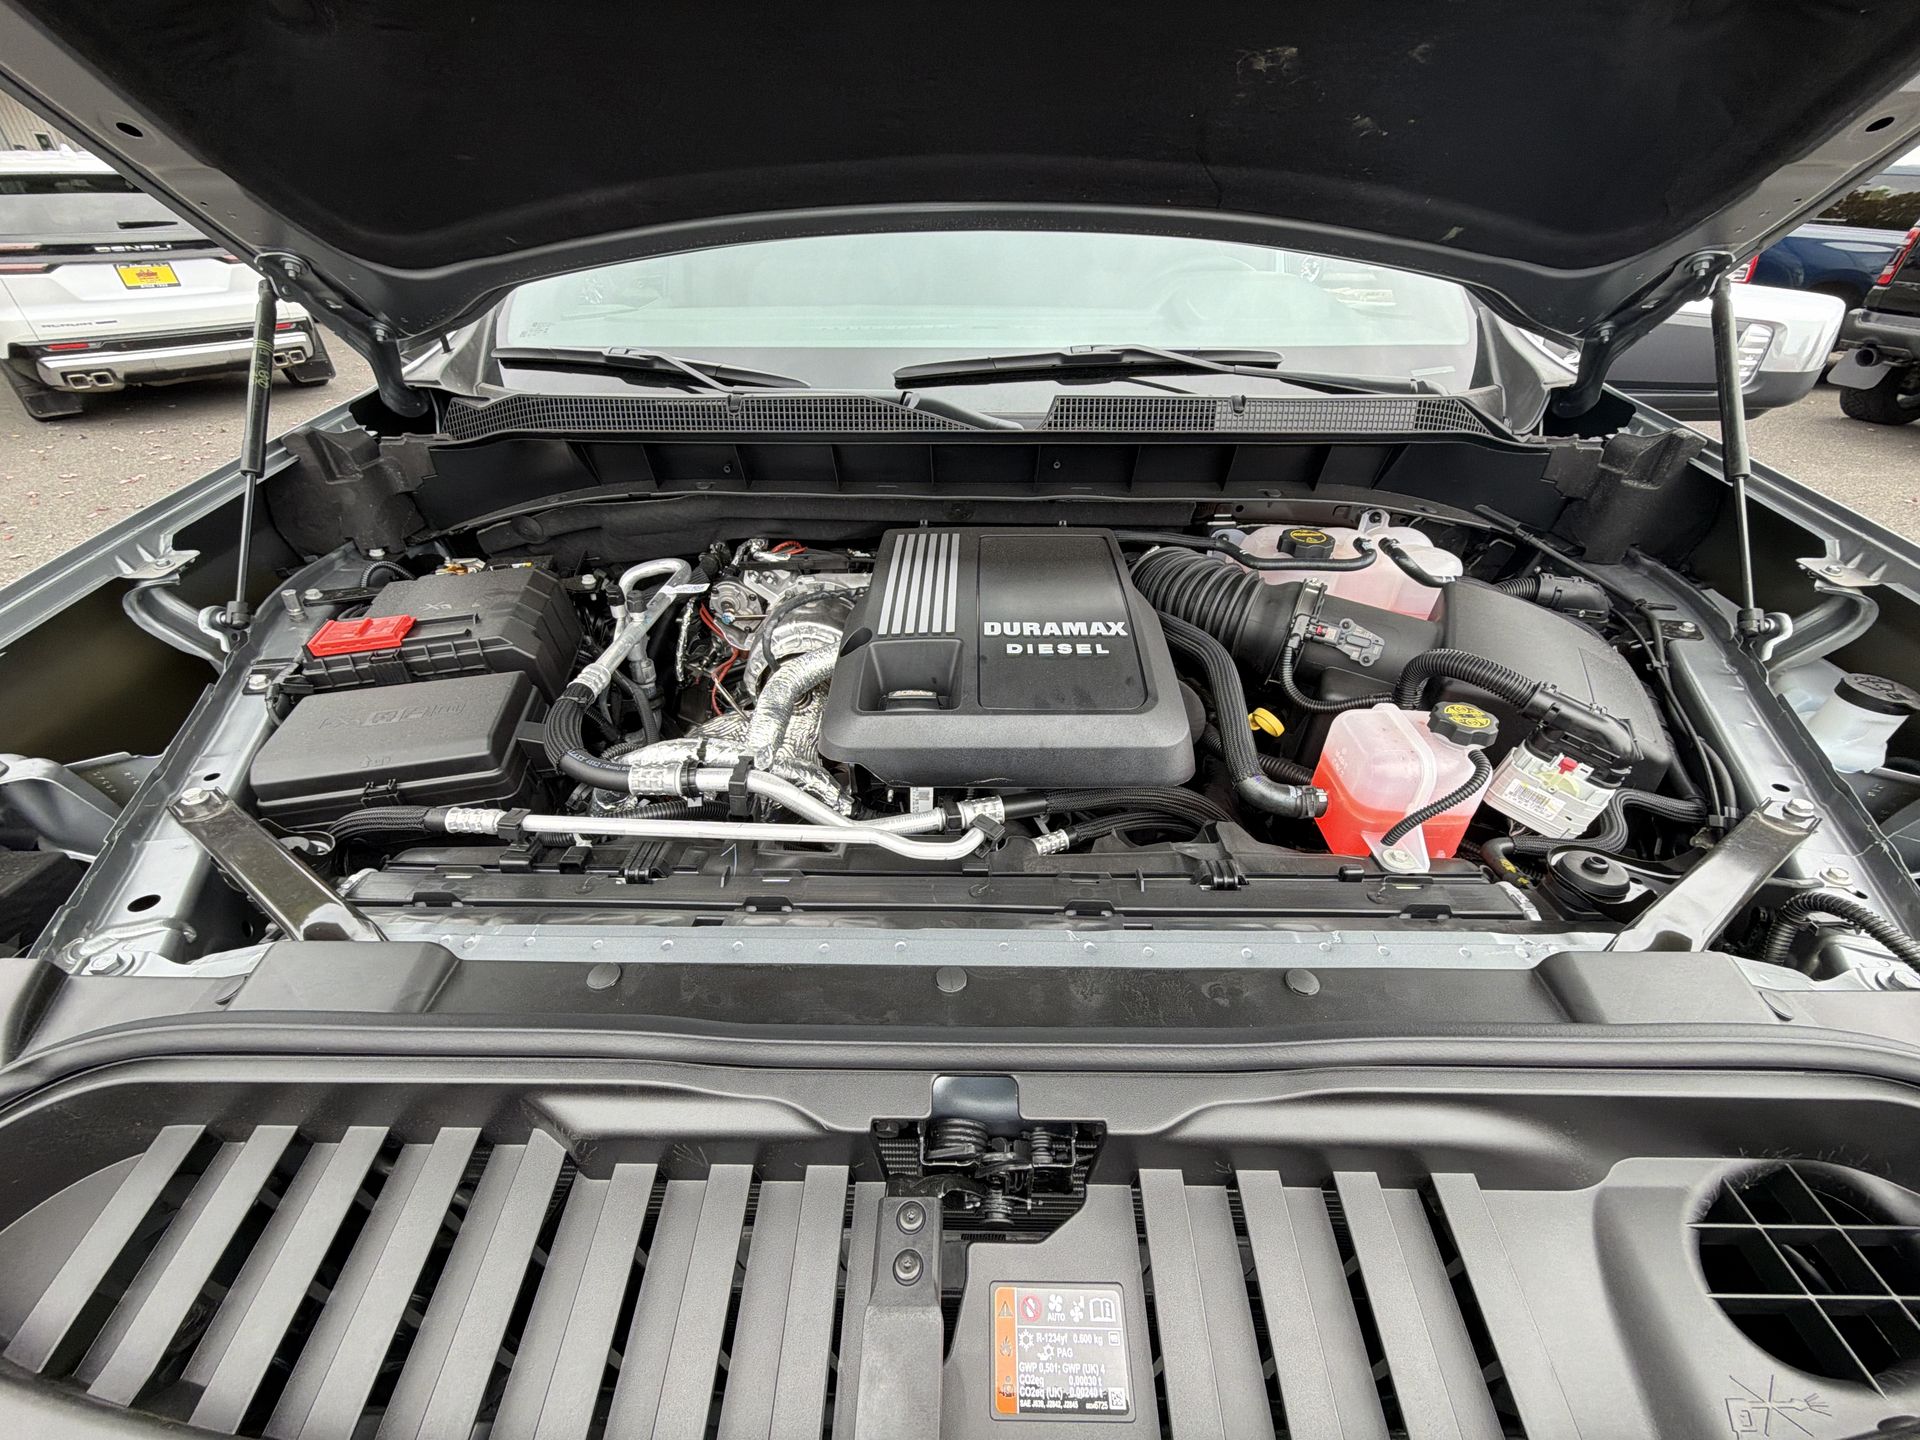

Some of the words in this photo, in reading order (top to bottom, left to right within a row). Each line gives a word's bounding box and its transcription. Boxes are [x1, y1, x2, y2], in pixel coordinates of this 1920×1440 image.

[94, 244, 172, 252] DENALI
[983, 621, 1128, 636] DURAMAX
[1006, 643, 1110, 654] DIESEL
[1047, 1312, 1066, 1322] AUTO
[1036, 1332, 1068, 1345] R-1234yf
[1093, 1334, 1104, 1347] kg
[1056, 1347, 1074, 1358] PAG
[1019, 1362, 1037, 1373] GWP
[1062, 1363, 1081, 1374] GWP
[1082, 1363, 1099, 1376] (UK)
[1100, 1364, 1106, 1375] 4
[1019, 1374, 1044, 1387] CO2eq
[1019, 1386, 1045, 1399] CO2eq
[1045, 1387, 1064, 1400] (UK)
